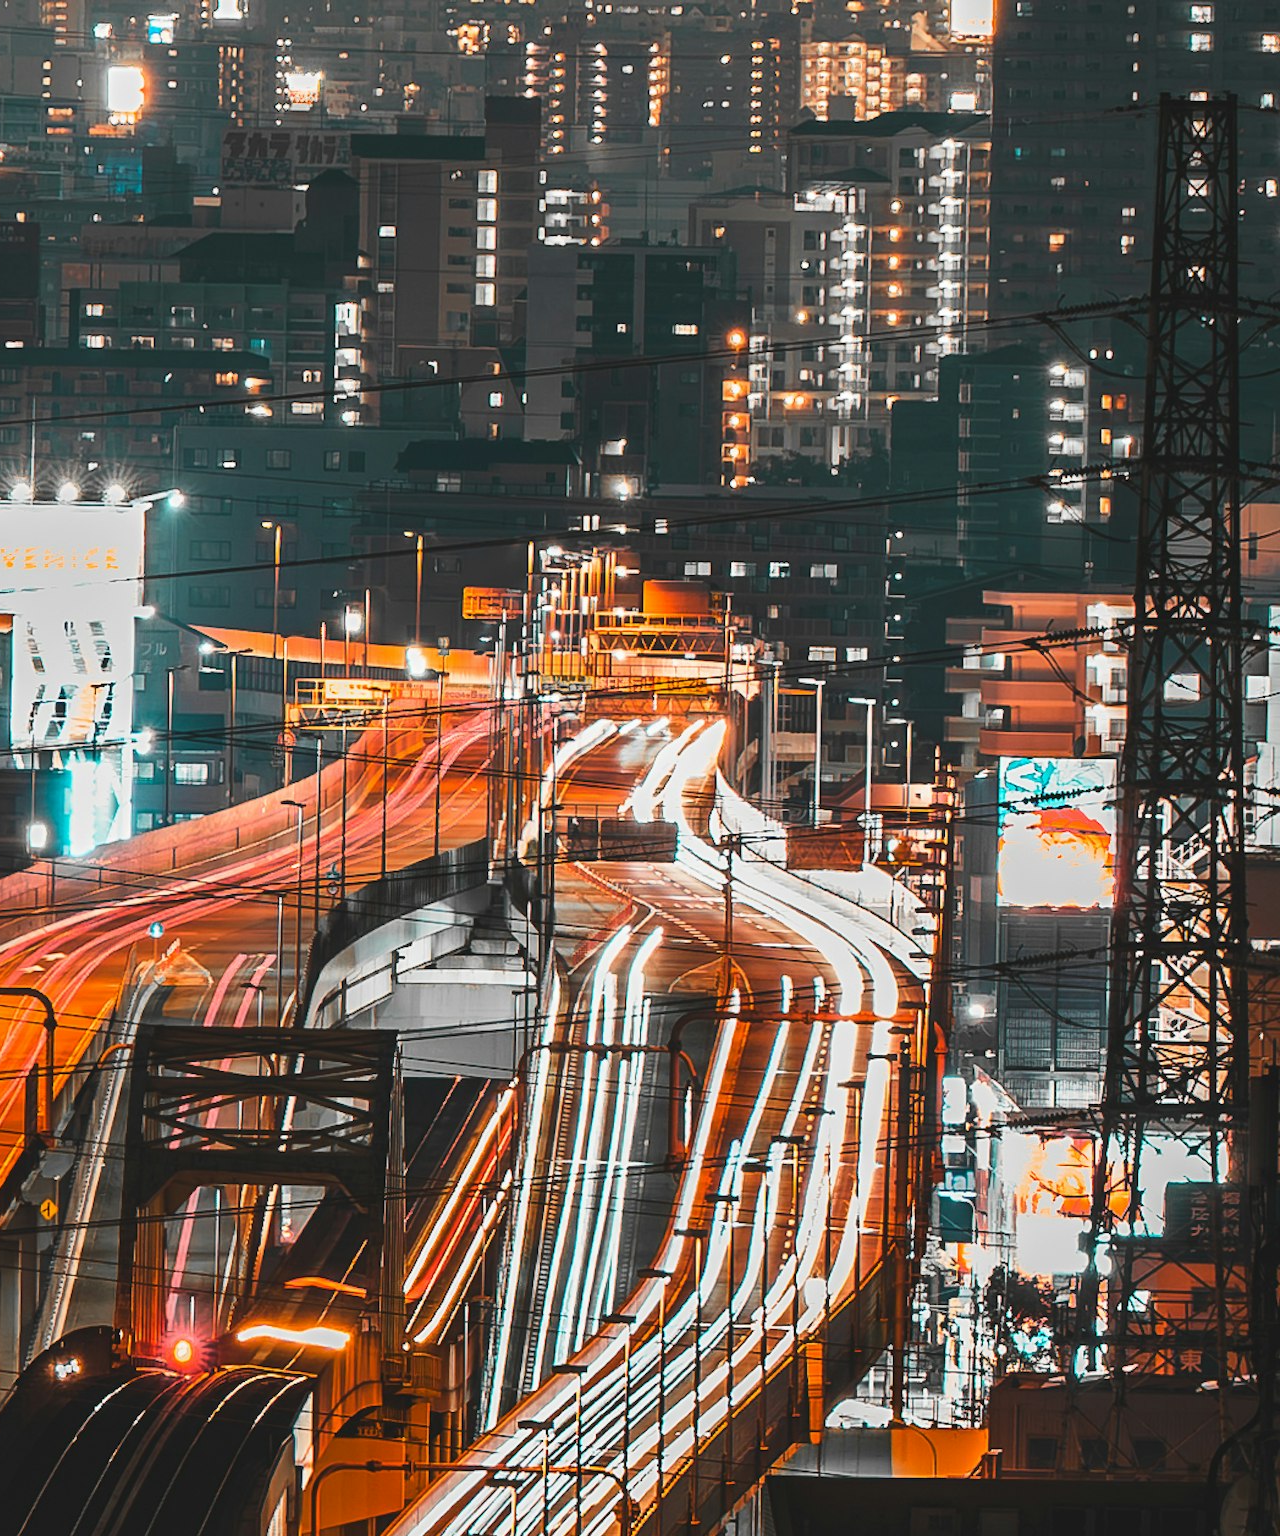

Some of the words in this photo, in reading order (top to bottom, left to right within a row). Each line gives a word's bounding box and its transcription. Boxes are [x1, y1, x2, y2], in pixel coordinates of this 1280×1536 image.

[223, 132, 291, 158] タカラ
[0, 546, 120, 570] VENICE
